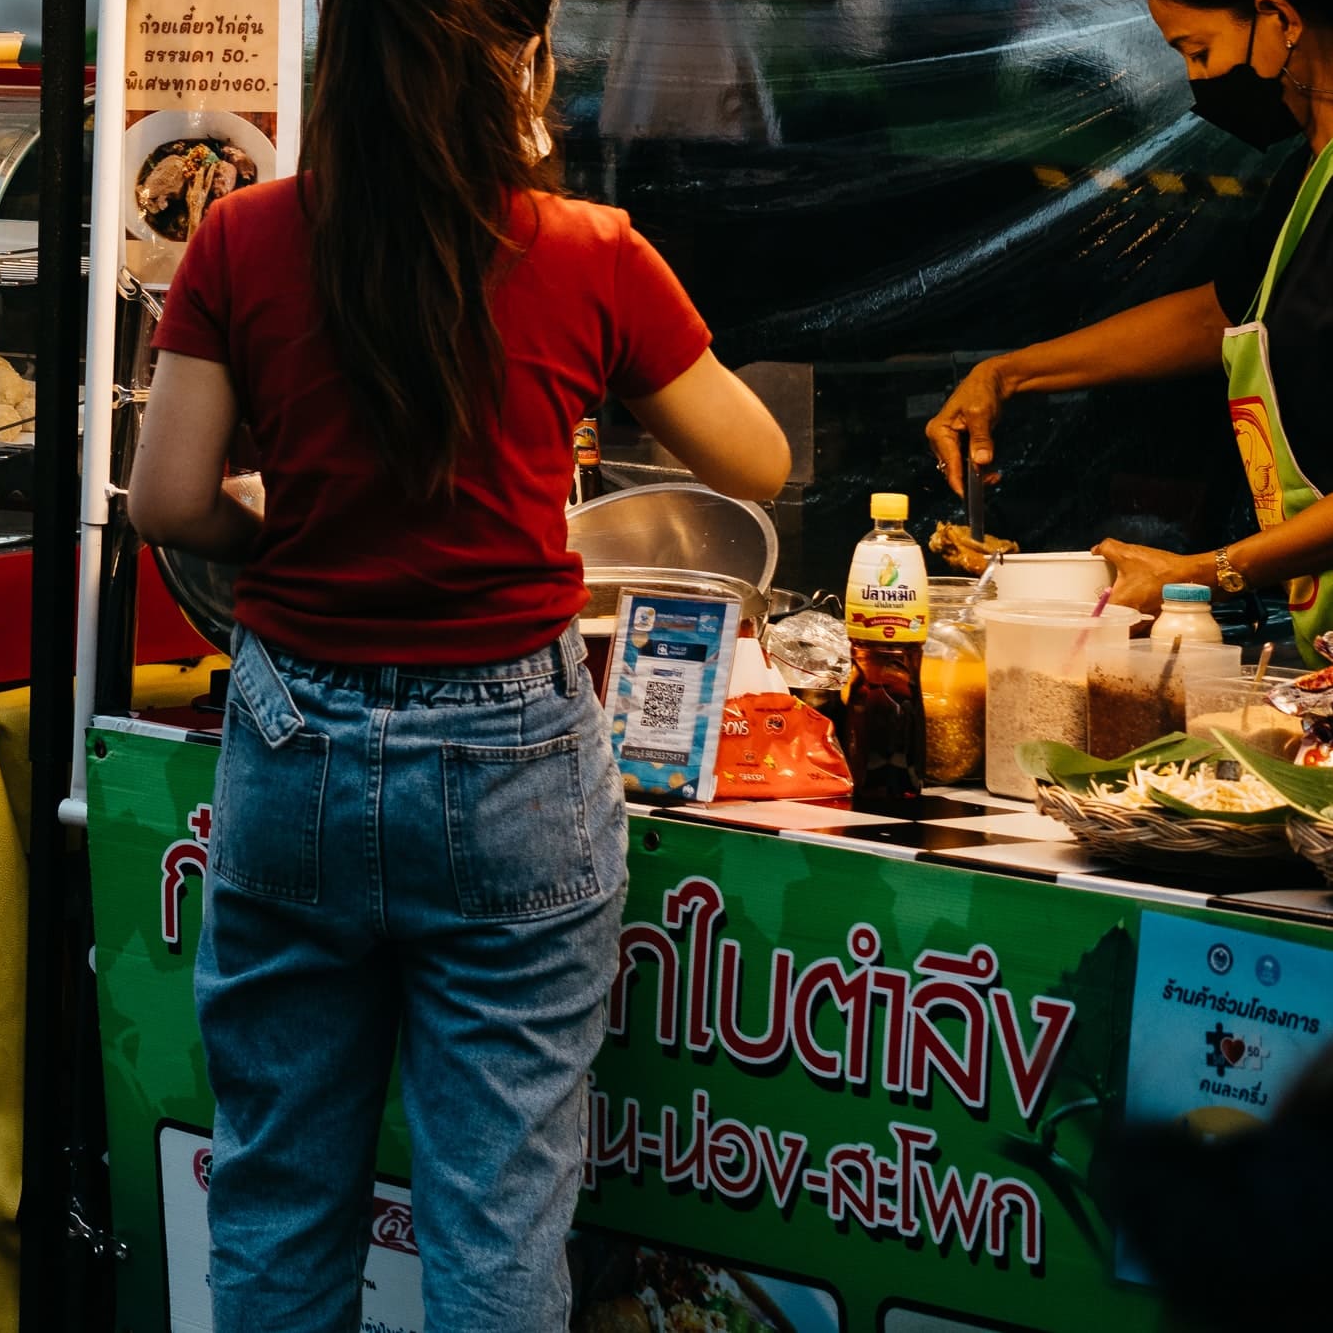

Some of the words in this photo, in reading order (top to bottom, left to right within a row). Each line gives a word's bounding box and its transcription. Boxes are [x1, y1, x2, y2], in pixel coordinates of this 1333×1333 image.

[140, 5, 264, 42] ก๋วยเตี๋ยวไก่ตุ๋น
[144, 49, 214, 63] ธรรมดา
[222, 49, 258, 63] 50.-
[861, 584, 917, 602] ปลาหมึก
[1162, 977, 1321, 1034] ร้านค้าร่วมโครงการ
[1247, 1046, 1260, 1057] 50
[1199, 1078, 1269, 1107] คนละครึ่ง
